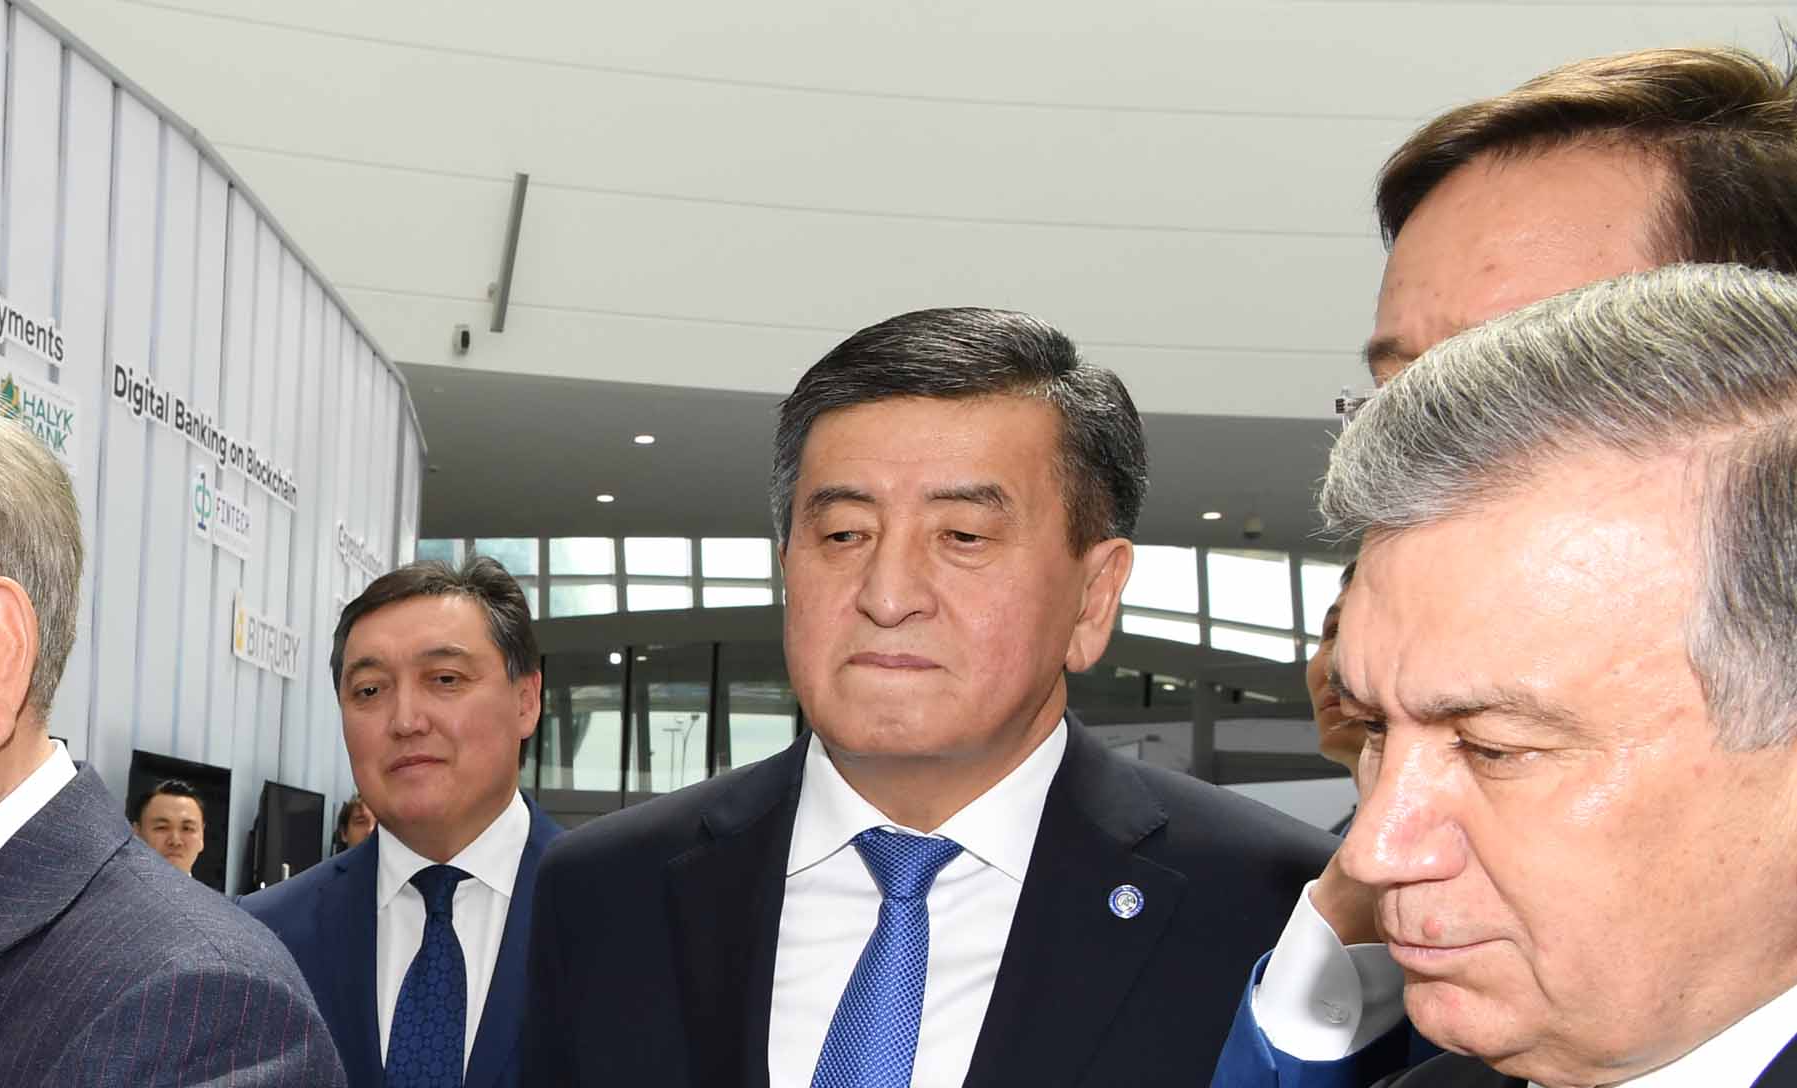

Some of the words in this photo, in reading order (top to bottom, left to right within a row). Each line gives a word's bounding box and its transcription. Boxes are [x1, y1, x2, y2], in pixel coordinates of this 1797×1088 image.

[22, 391, 73, 434] HALYK
[114, 364, 170, 424] Digital
[175, 399, 227, 465] Banking
[230, 442, 244, 469] on
[247, 446, 297, 506] Blockchain
[247, 616, 301, 673] BITFURY
